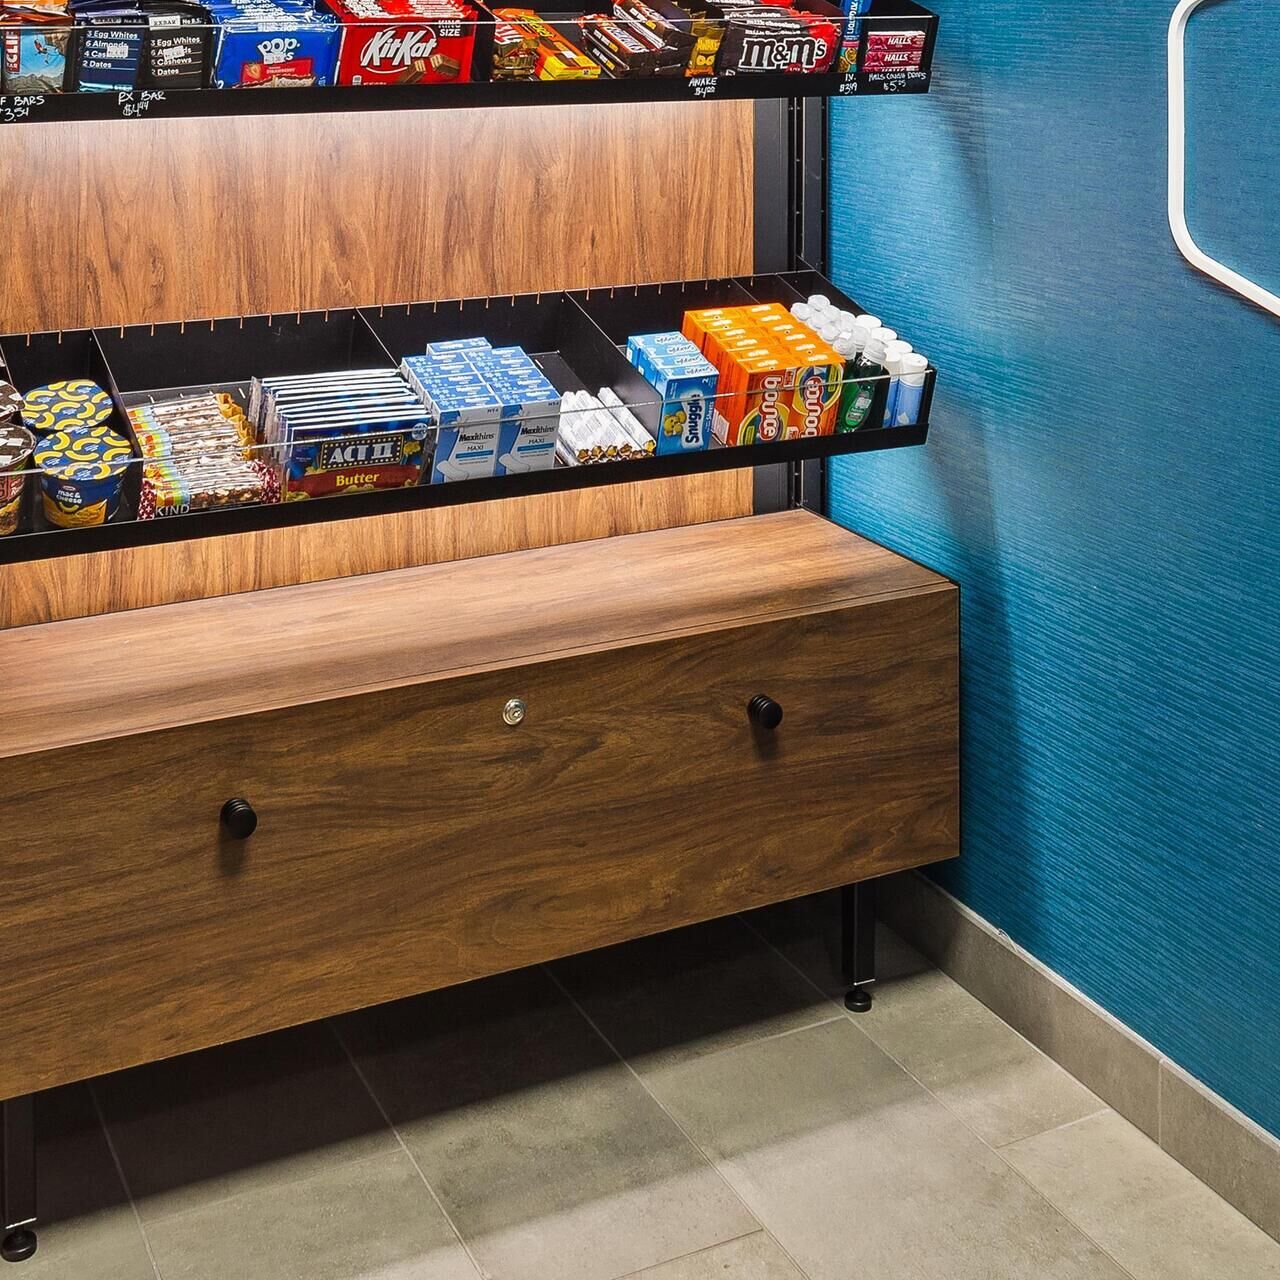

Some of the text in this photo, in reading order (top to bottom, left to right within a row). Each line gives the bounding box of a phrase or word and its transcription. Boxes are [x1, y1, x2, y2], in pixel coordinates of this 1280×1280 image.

[93, 31, 109, 39] Egg
[110, 31, 138, 39] Whites
[439, 28, 461, 37] SIZE
[157, 39, 172, 47] Egg
[173, 37, 200, 45] Whites
[887, 36, 912, 45] HALLS
[360, 30, 438, 67] KitKat
[157, 58, 192, 66] Cashews
[883, 53, 909, 62] HALLS
[13, 95, 45, 106] BARS
[141, 91, 167, 101] BAR
[763, 376, 782, 436] bounce
[520, 424, 555, 436] Maxithins
[459, 432, 495, 443] Maxithins
[328, 442, 394, 464] ACT II
[335, 472, 380, 487] Butter
[155, 504, 190, 517] KIND
